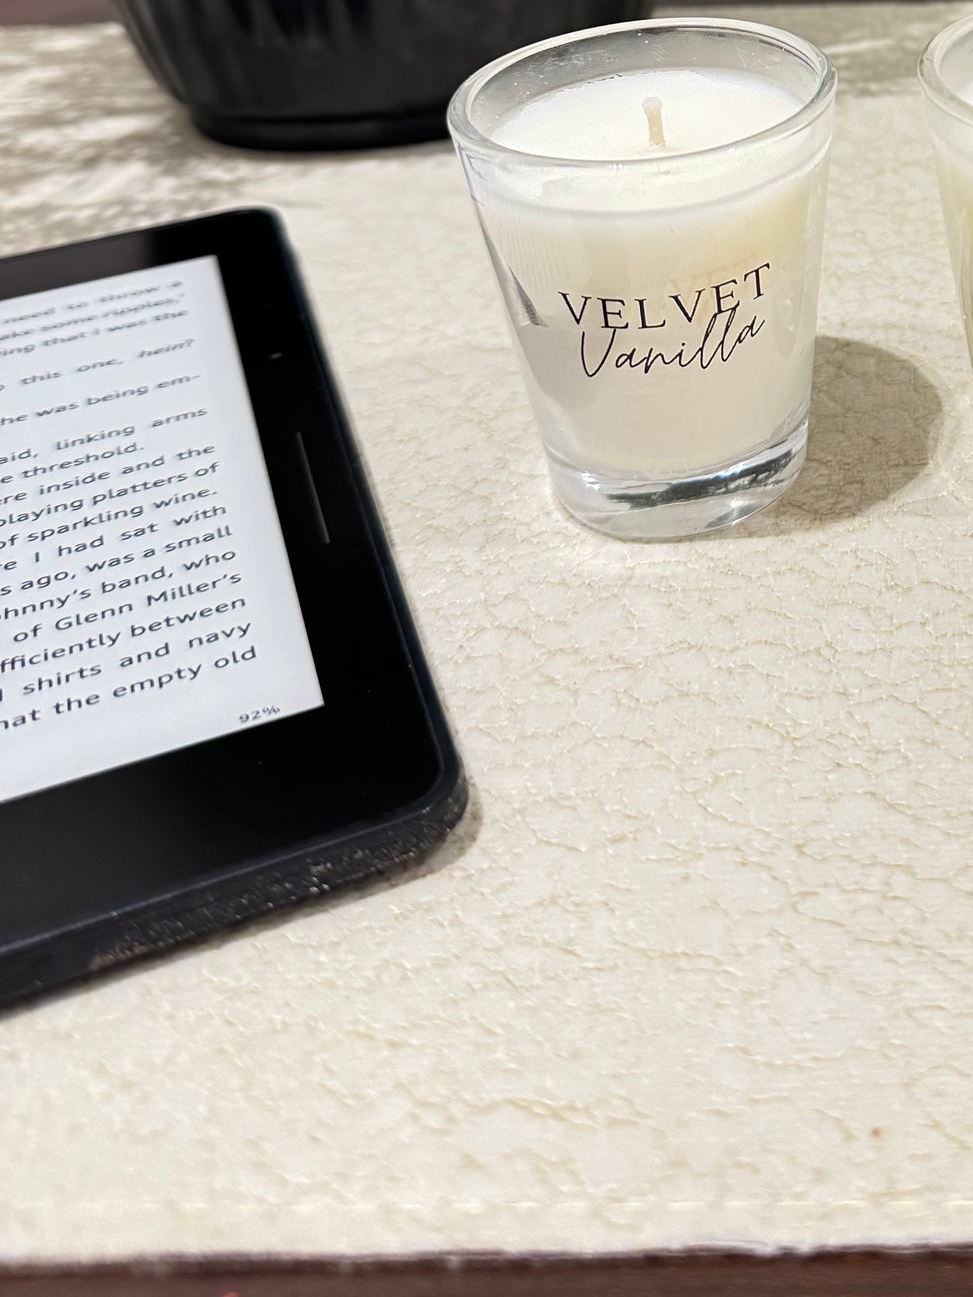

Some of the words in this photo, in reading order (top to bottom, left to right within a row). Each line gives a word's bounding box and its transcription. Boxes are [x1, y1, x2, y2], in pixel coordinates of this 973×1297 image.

[558, 262, 772, 330] VELVET
[0, 341, 36, 357] ing
[42, 329, 88, 347] that
[107, 319, 146, 333] was
[20, 370, 63, 386] this
[75, 357, 124, 374] one,
[137, 338, 196, 359] hein?
[580, 305, 766, 378] Vanilla
[35, 402, 80, 417] was
[86, 384, 149, 406] being
[156, 374, 202, 389] em-
[21, 441, 145, 478] threshold.
[56, 424, 136, 450] linking
[150, 406, 208, 428] arms
[0, 490, 28, 503] re
[38, 468, 111, 494] inside
[120, 455, 166, 475] and
[175, 443, 216, 461] the
[91, 471, 188, 503] platters
[194, 461, 220, 477] of
[0, 560, 17, 572] e
[57, 534, 105, 558] had
[119, 521, 160, 541] sat
[172, 503, 227, 526] with
[27, 503, 145, 542] sparkling
[152, 487, 219, 509] wine.
[0, 587, 92, 621] hnny’s
[101, 567, 175, 594] band,
[182, 548, 237, 571] who
[20, 571, 77, 591] ago,
[85, 552, 134, 573] was
[142, 546, 157, 559] a
[164, 525, 233, 553] small
[0, 631, 121, 674] fficiently
[130, 597, 247, 638] between
[12, 624, 43, 643] of
[54, 601, 134, 632] Glenn
[147, 573, 243, 607] Miller’s
[22, 664, 102, 696] shirts
[119, 642, 171, 668] and
[187, 621, 252, 649] navy
[53, 691, 101, 715] the
[112, 665, 203, 698] empty
[213, 645, 258, 670] old
[239, 704, 281, 724] 92%
